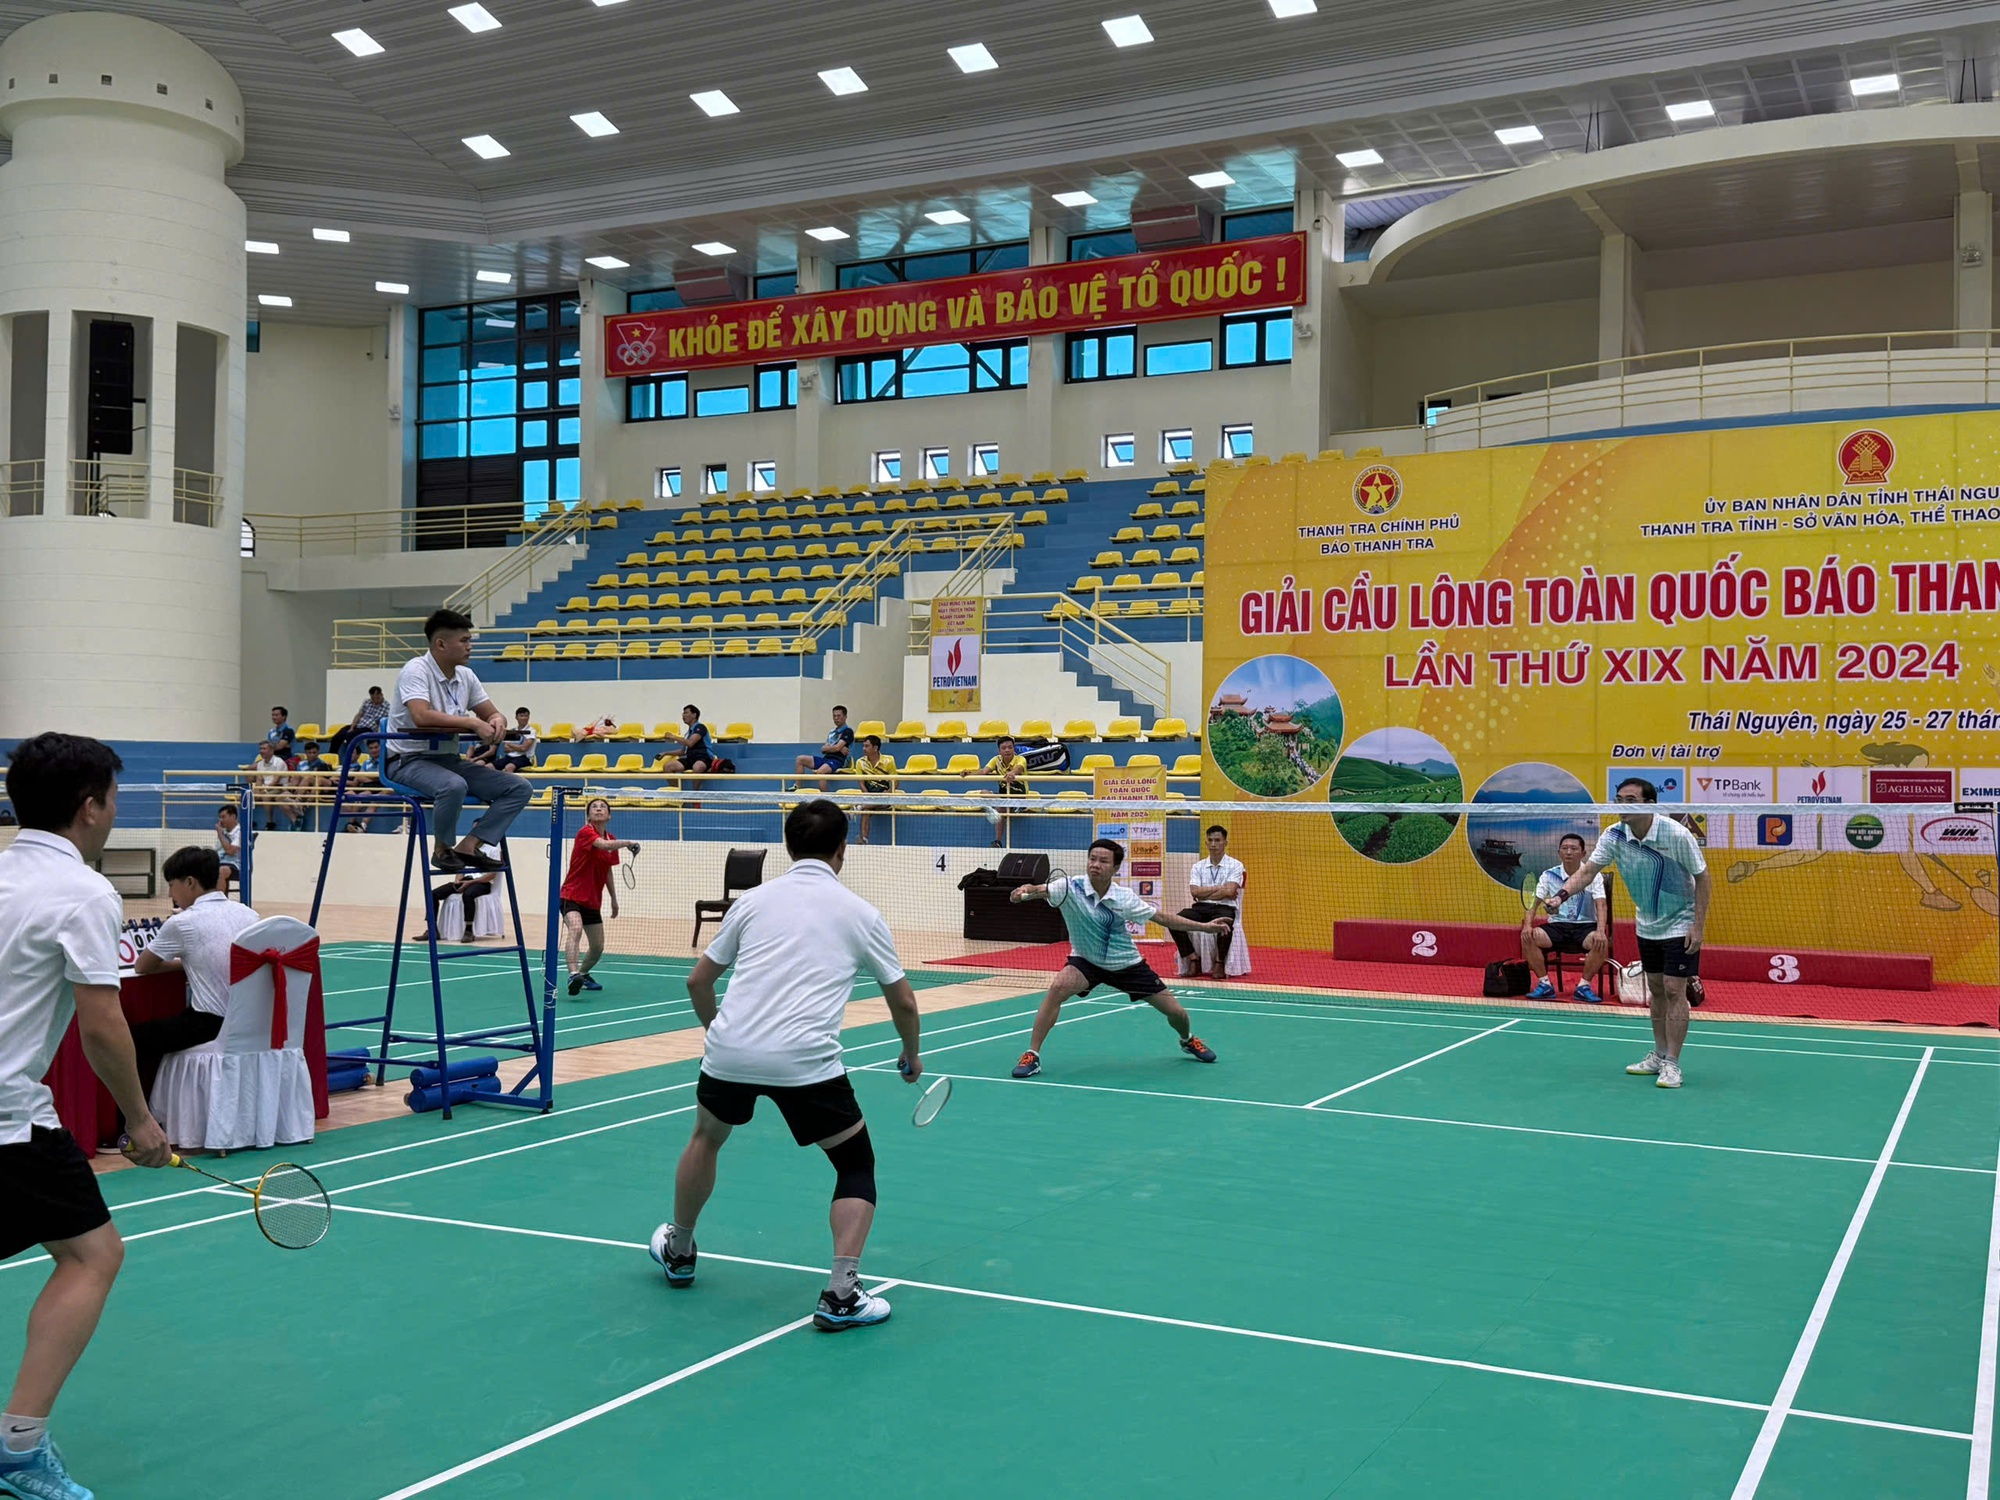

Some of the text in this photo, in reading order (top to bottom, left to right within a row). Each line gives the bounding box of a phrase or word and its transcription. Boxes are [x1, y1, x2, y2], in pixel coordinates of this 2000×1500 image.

[668, 251, 1286, 358] KHỎE ĐỂ XÂY DỤNG VÀ BẢO VỆ TỔ QUỐC !
[1705, 486, 2000, 514] ỦY BAN NHÂN DÂN TỈNH THÁI NGU
[1298, 513, 1460, 538] THANH TRA CHÍNH PHỦ
[1641, 524, 1695, 537] THANH
[1701, 521, 1733, 534] TRA
[1739, 515, 1777, 532] TỈNH
[1793, 513, 1818, 529] SỞ
[1823, 510, 1857, 526] VĂN
[1863, 509, 1905, 526] HÓA,
[1910, 504, 1945, 523] THỂ
[1951, 507, 2000, 521] THAO
[1321, 537, 1434, 554] BÁO THANH TRA
[1241, 575, 1311, 635] GIẢI
[1324, 571, 1397, 631] CẦU
[1410, 573, 1512, 629] LÔNG
[1526, 565, 1634, 624] TOÀN
[1651, 553, 1767, 625] QUỐC
[1784, 556, 1875, 616] BÁO
[1386, 636, 1959, 687] LẦN THỨ XIX NĂM 2024
[933, 676, 977, 687] PETROVIETNAM
[1689, 711, 1730, 730] Thái
[1736, 711, 1818, 733] Nguyên,
[1826, 709, 1876, 734] ngày
[1882, 711, 1907, 729] 25
[1926, 711, 1952, 729] 27
[1612, 743, 1721, 760] Đơn vị tài trợ
[1714, 779, 1761, 791] TPBank
[1888, 785, 1945, 793] AGRIBANK
[1942, 828, 1979, 836] WIN
[936, 854, 946, 871] 4
[134, 934, 144, 948] 0
[1411, 930, 1438, 957] 2
[1768, 954, 1800, 983] 3
